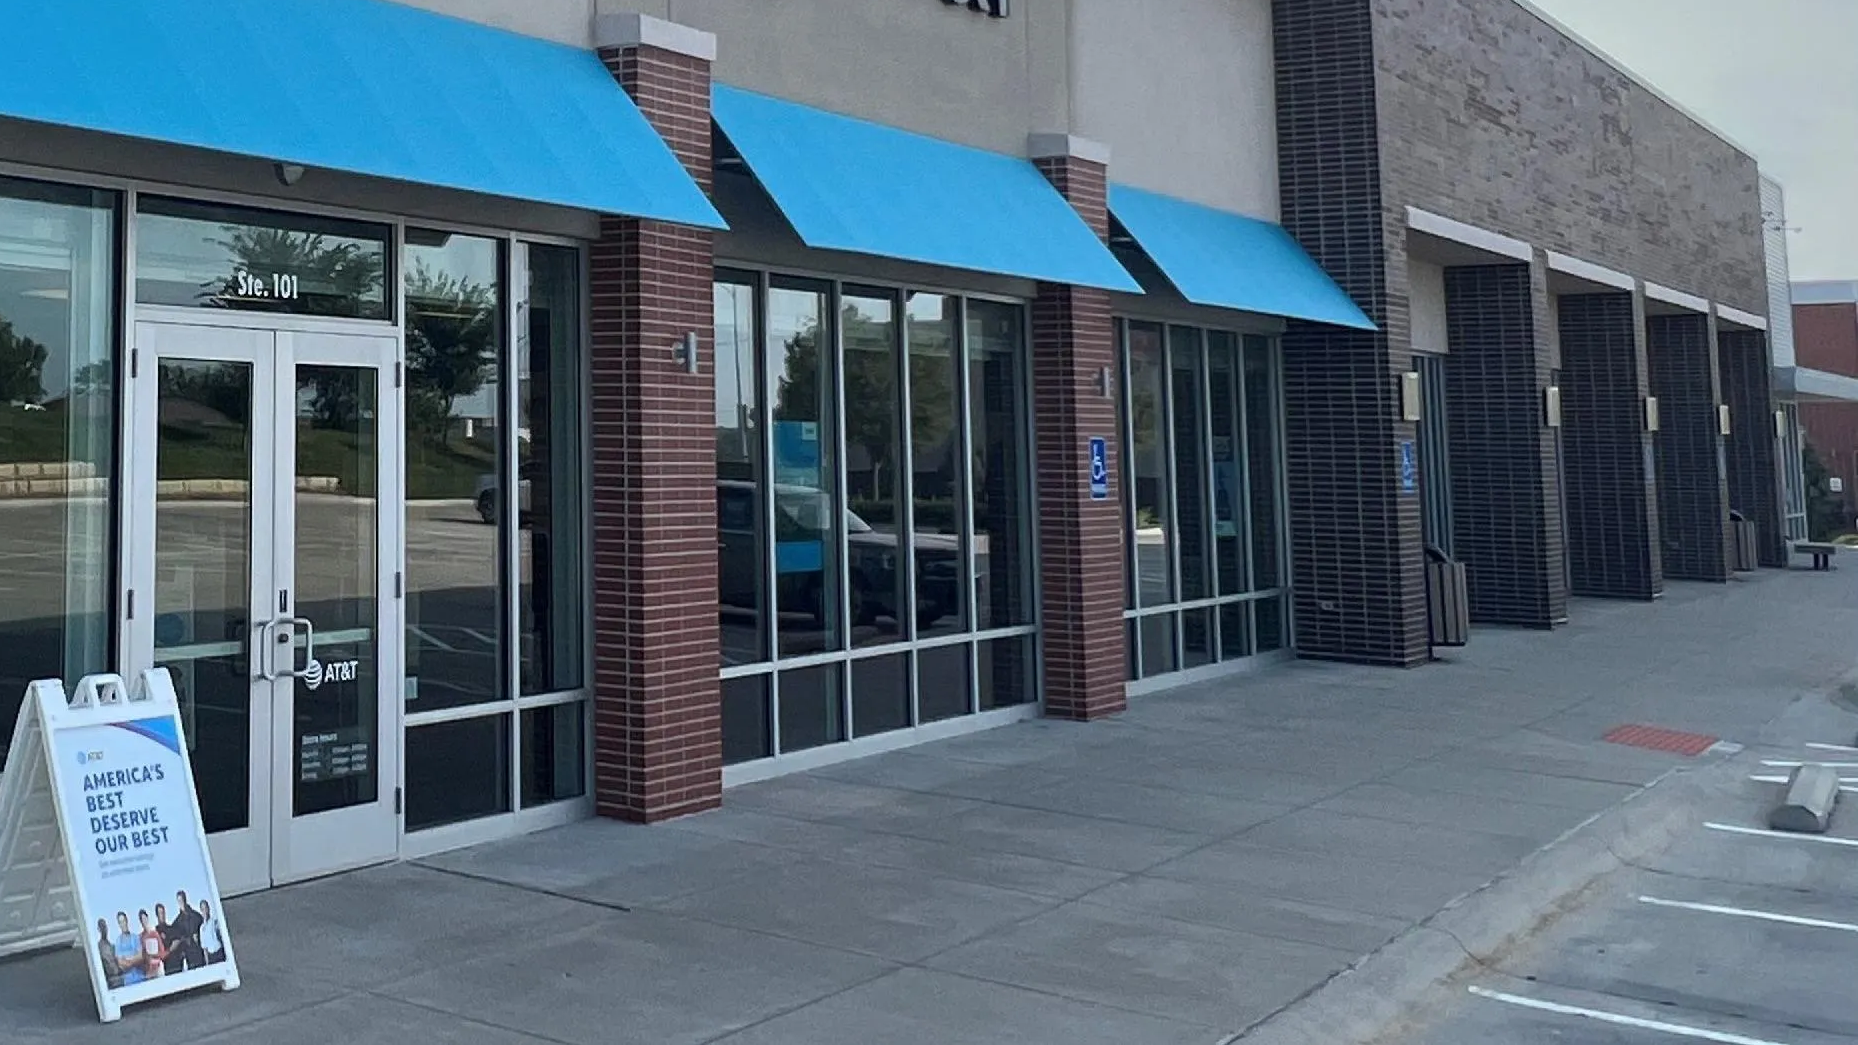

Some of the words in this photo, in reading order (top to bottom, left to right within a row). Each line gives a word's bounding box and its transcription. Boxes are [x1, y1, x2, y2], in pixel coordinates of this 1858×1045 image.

[238, 270, 269, 297] Ste.
[272, 273, 298, 300] 101
[324, 660, 359, 683] AT&T
[83, 763, 165, 792] AMERICA'S
[86, 791, 124, 813] BEST
[90, 806, 160, 834] DESERVE
[95, 833, 129, 855] OUR
[131, 826, 169, 848] BEST
